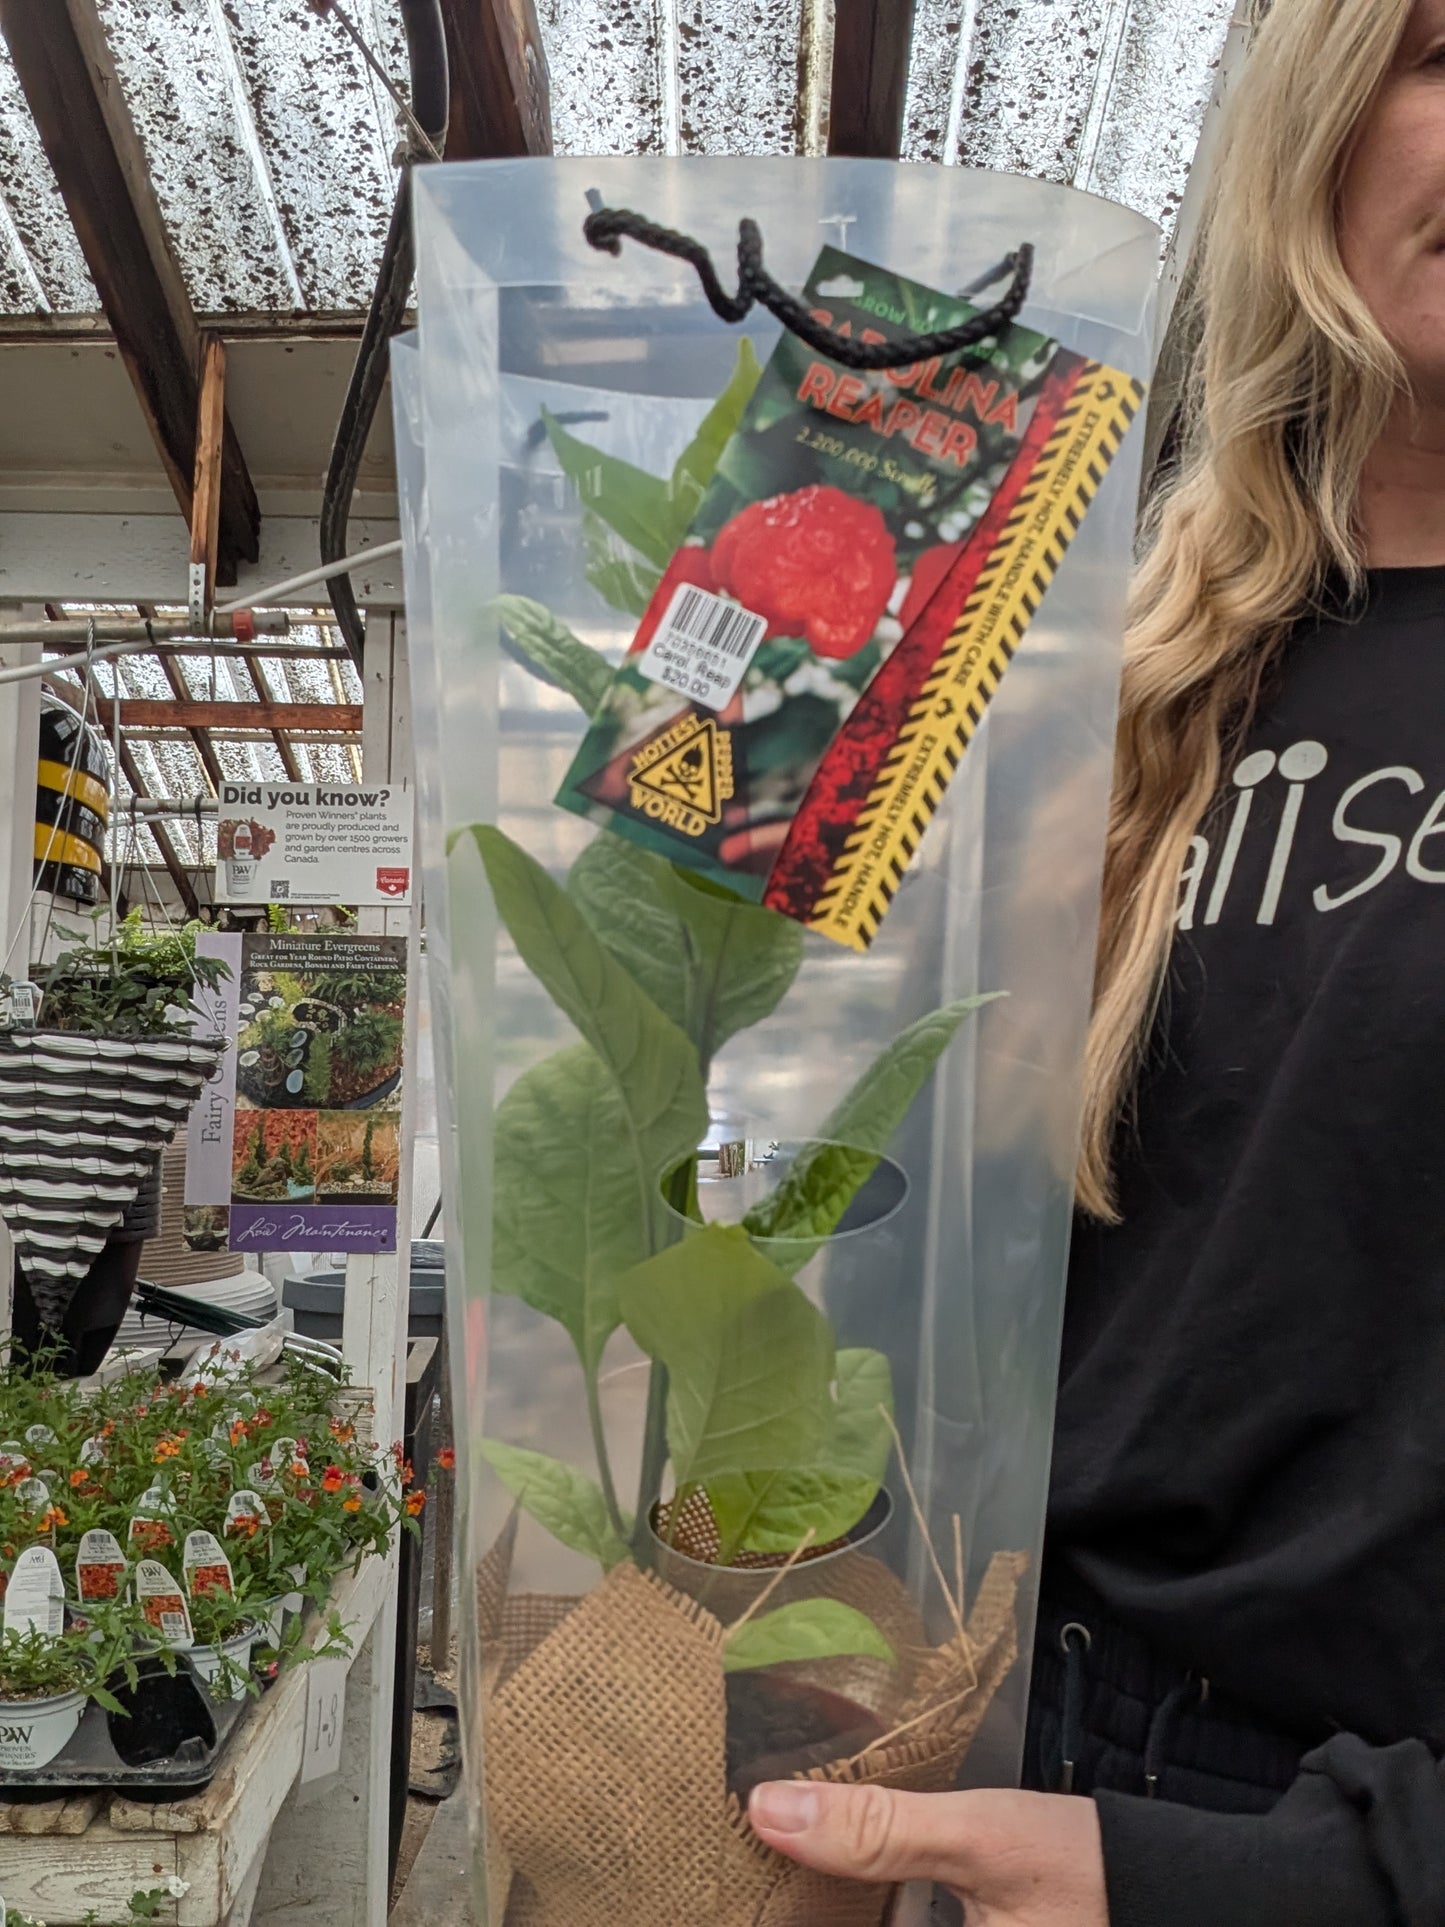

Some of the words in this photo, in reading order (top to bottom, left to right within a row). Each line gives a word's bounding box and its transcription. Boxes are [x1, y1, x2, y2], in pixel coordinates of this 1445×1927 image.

[797, 361, 978, 467] REAPER
[1051, 410, 1099, 497] EXTREMELY
[997, 537, 1038, 602] HANDLE
[978, 601, 1003, 645] WITH
[662, 665, 710, 698] $20.00
[697, 660, 732, 691] Reap
[953, 645, 982, 688] CARE
[631, 712, 701, 769] HOTTEST
[224, 786, 262, 805] Did
[267, 791, 310, 810] you
[316, 788, 390, 807] know?
[888, 734, 938, 821] EXTREMELY
[286, 811, 316, 819] Proven
[360, 812, 387, 821] plants
[302, 823, 336, 832] proudly
[338, 823, 380, 832] produced
[630, 789, 707, 837] WORLD
[285, 834, 313, 842] grown
[315, 833, 326, 842] by
[350, 835, 371, 843] 1500
[372, 836, 408, 844] growers
[285, 844, 302, 852] and
[304, 844, 335, 853] garden
[337, 845, 370, 853] centres
[834, 859, 875, 928] HANDLE
[270, 940, 321, 951] Miniature
[324, 940, 381, 953] Evergreens
[270, 961, 304, 969] GARDENS,
[366, 962, 399, 970] GARDENS
[207, 1000, 227, 1084] Gdens
[202, 1091, 229, 1144] Fairy
[237, 1216, 277, 1242] Low
[282, 1214, 389, 1241] Maintenance
